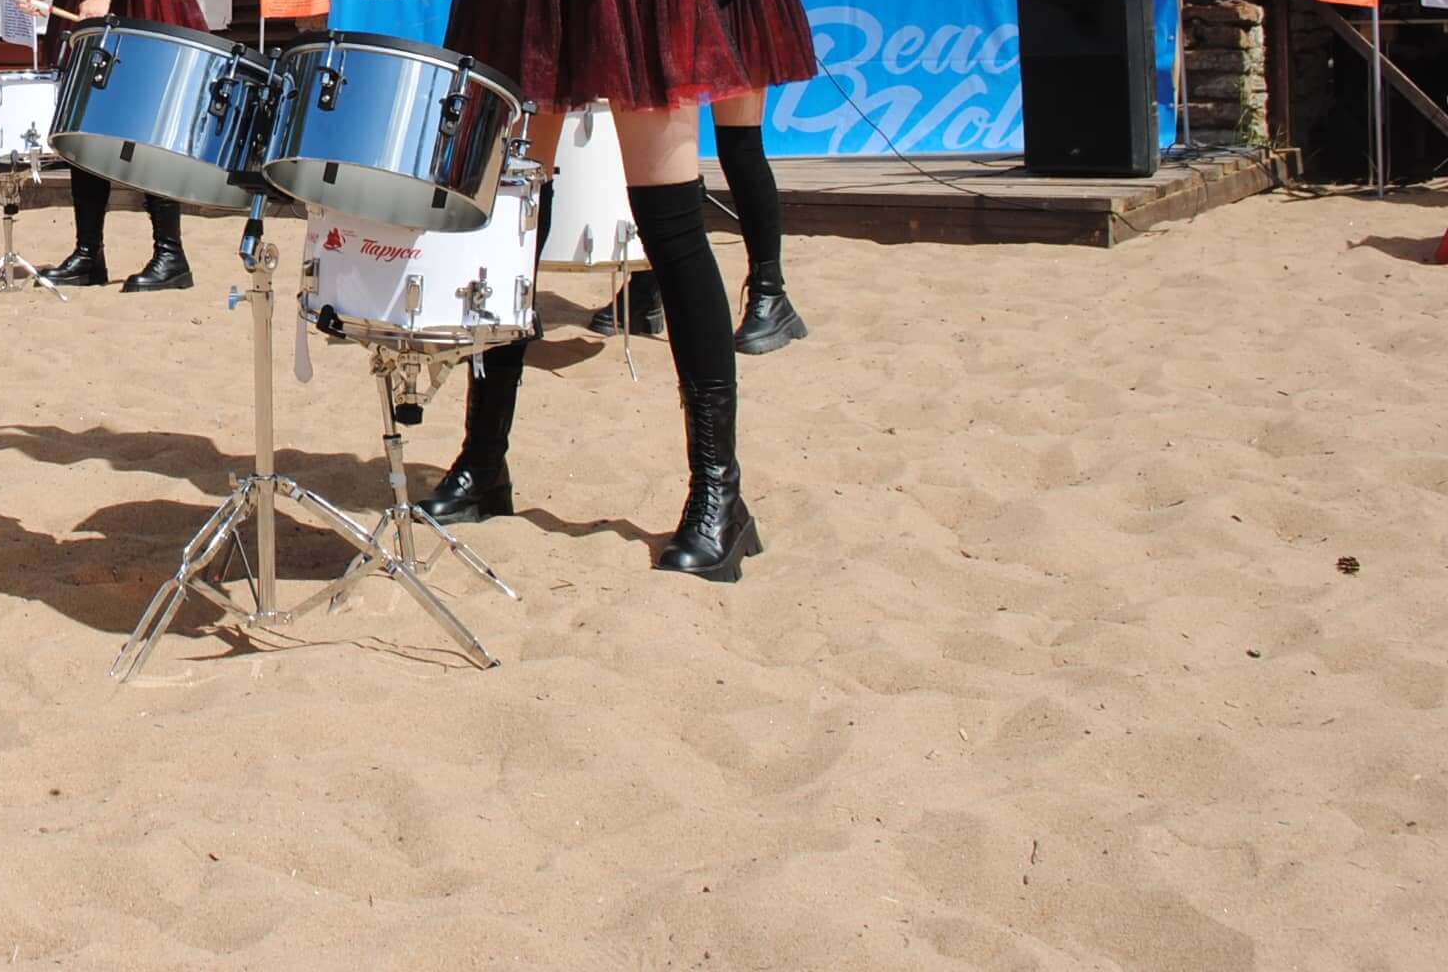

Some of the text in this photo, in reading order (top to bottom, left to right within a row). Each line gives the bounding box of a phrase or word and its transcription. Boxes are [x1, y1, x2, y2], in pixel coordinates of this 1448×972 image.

[771, 6, 1021, 132] Beac
[831, 74, 1023, 156] Vol
[360, 238, 422, 262] Паруса
